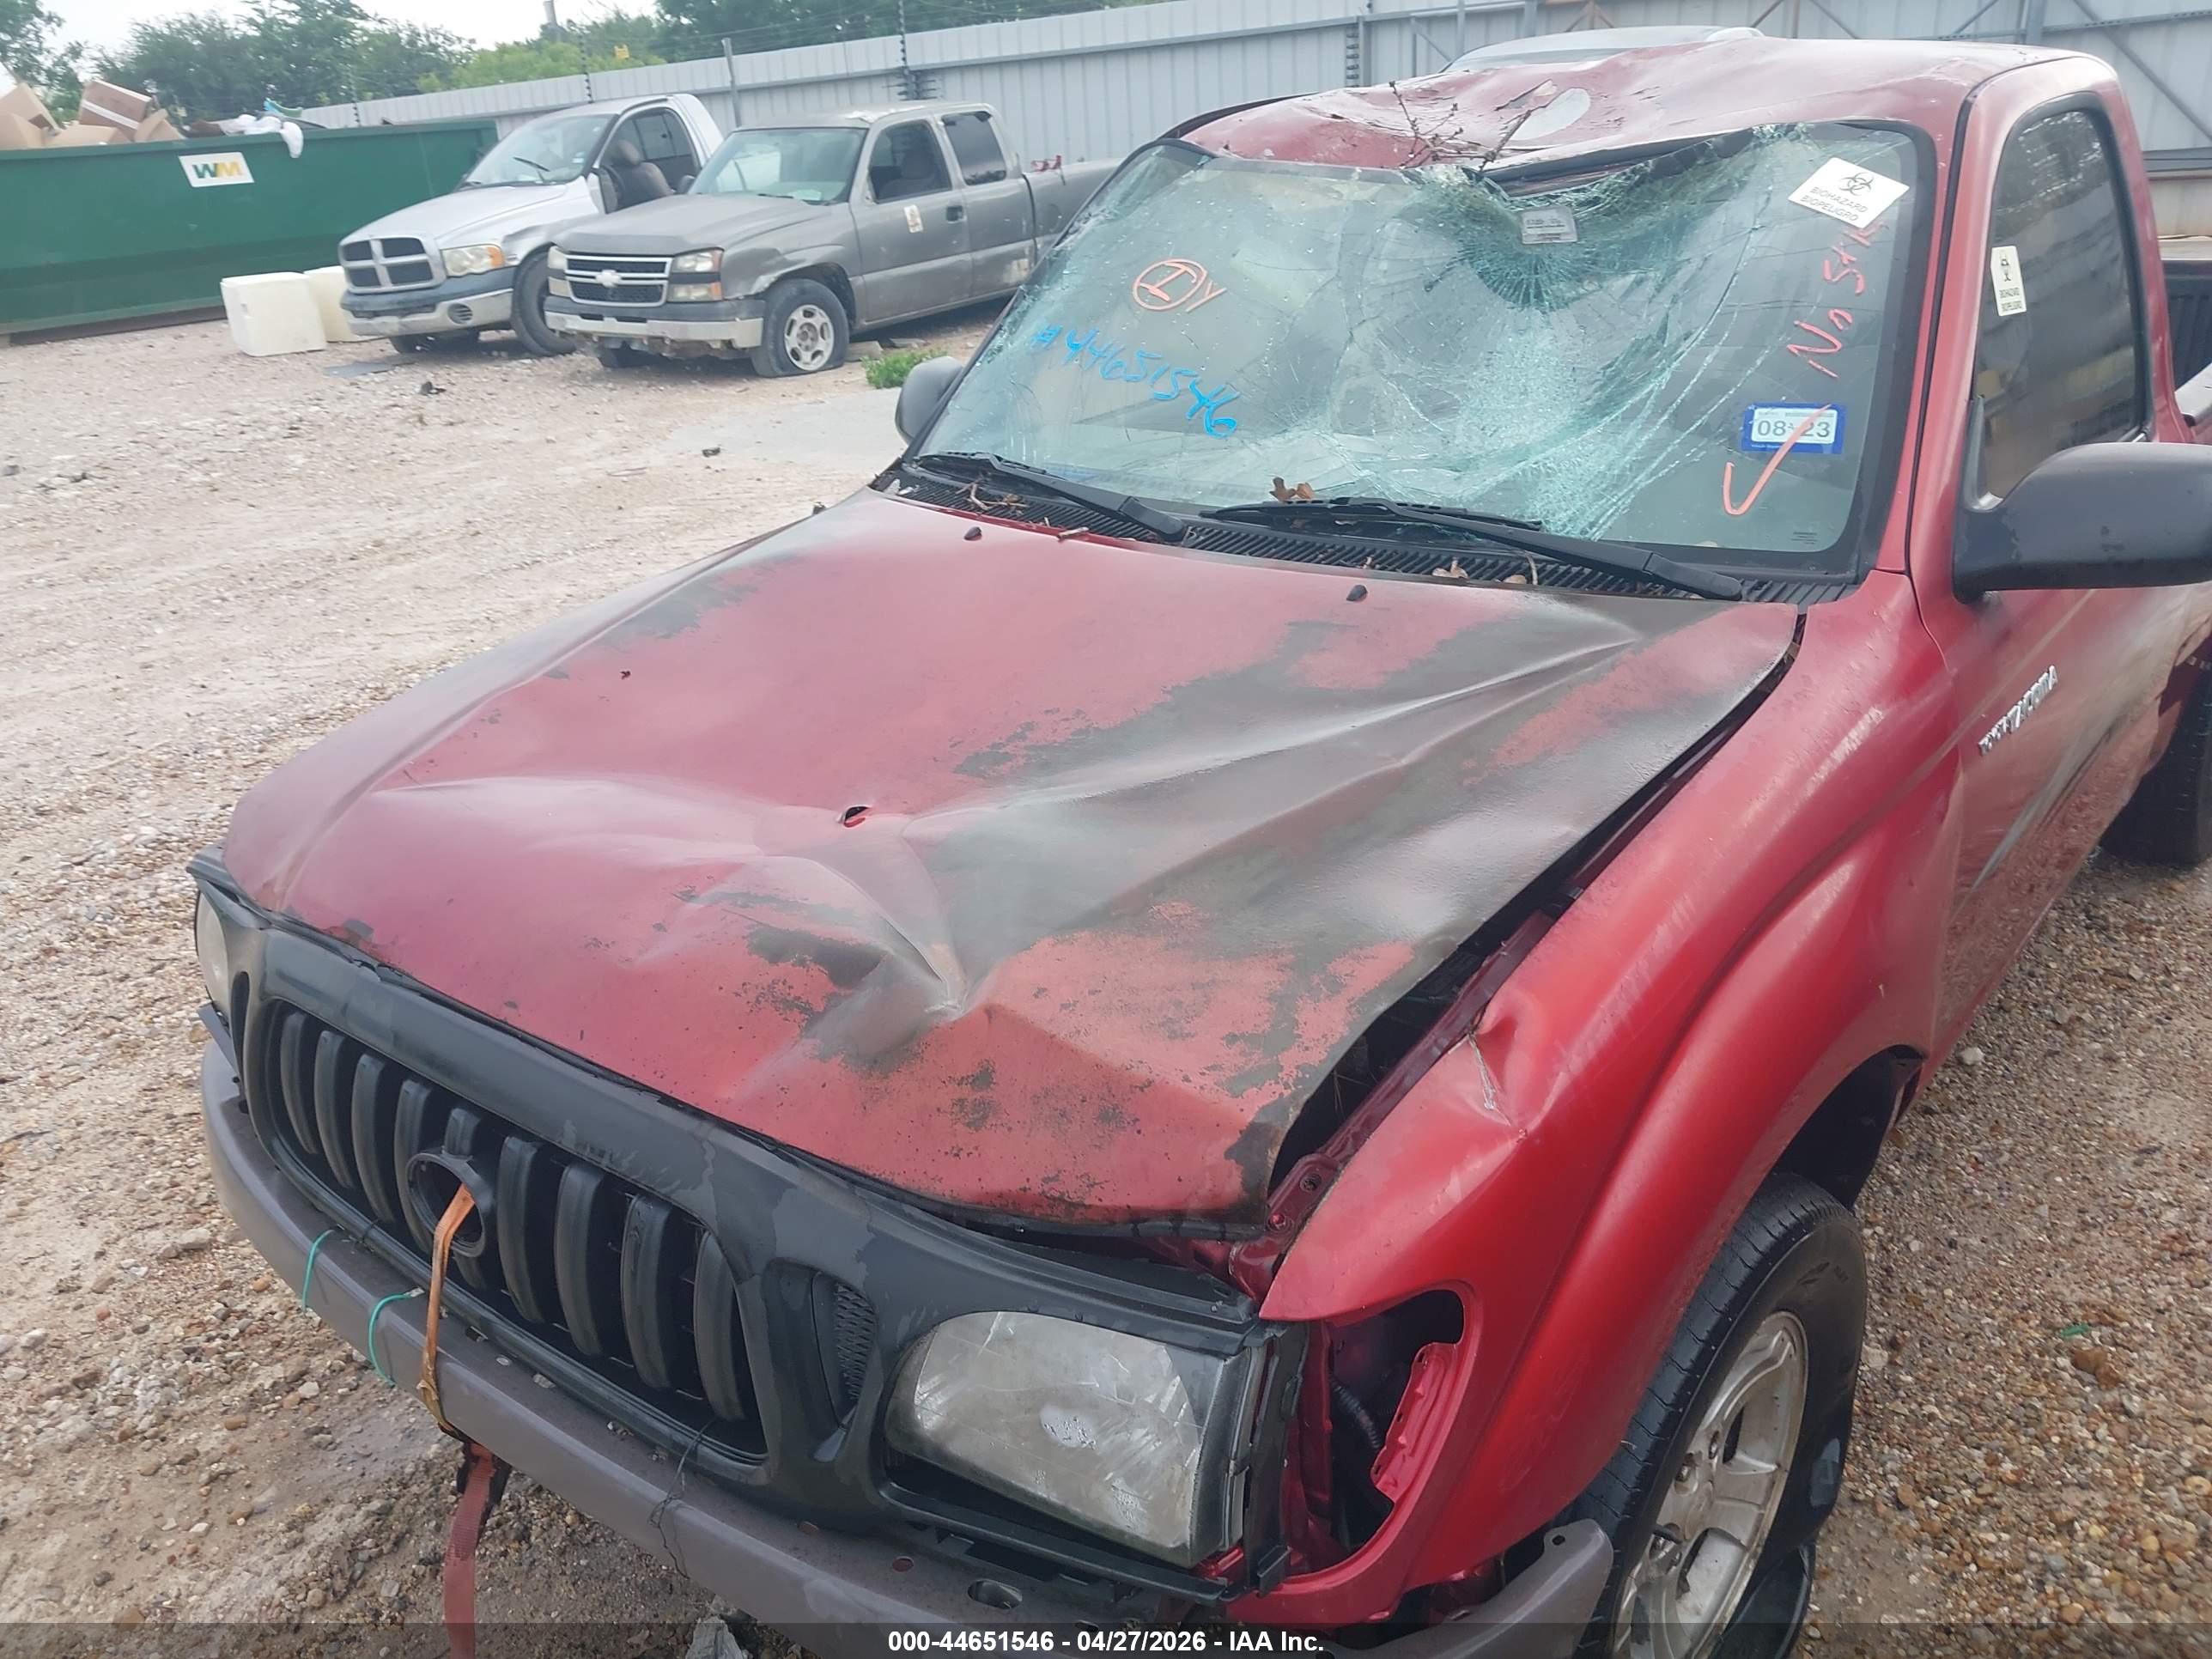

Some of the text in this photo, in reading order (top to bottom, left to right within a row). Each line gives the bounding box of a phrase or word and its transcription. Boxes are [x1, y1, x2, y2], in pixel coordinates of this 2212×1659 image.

[191, 161, 244, 179] WM
[1800, 194, 1859, 222] BIOPELIGRO
[1809, 186, 1868, 214] BIOHAZARD
